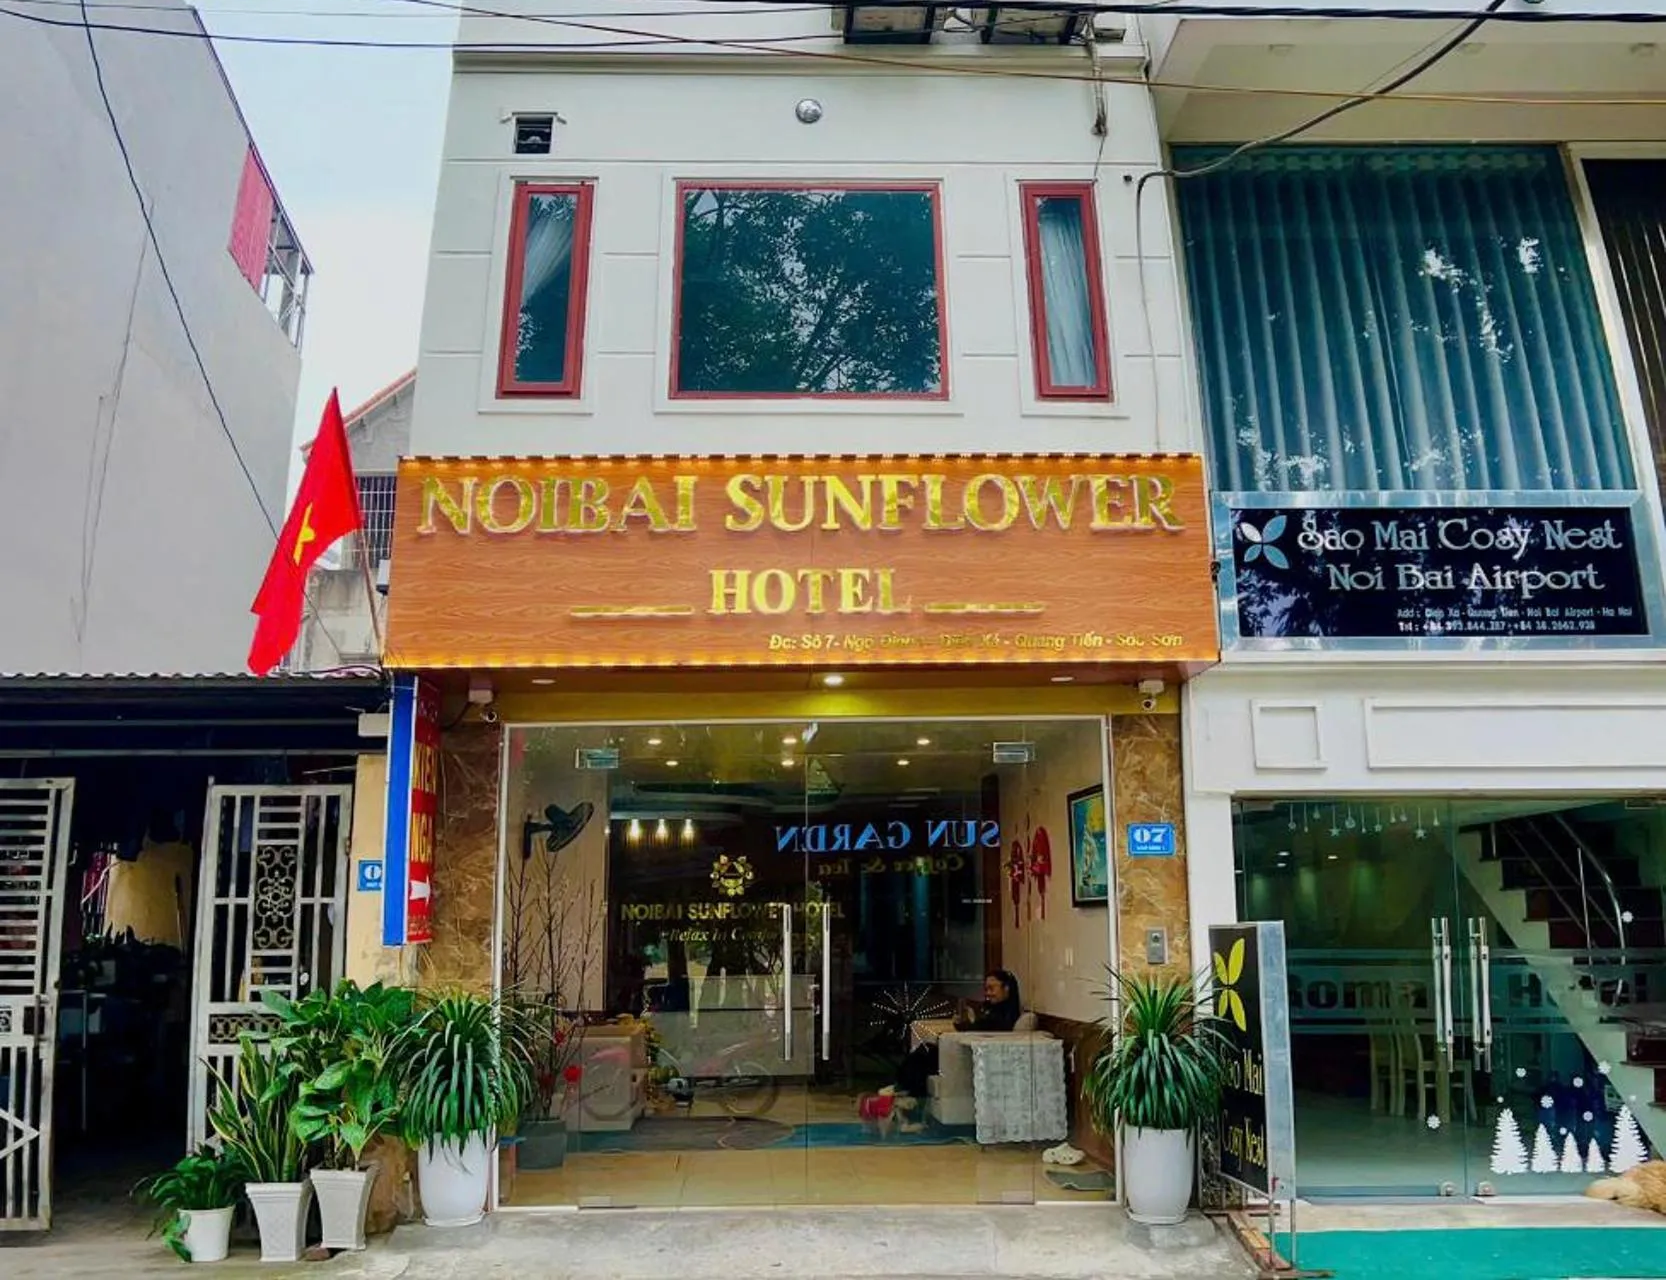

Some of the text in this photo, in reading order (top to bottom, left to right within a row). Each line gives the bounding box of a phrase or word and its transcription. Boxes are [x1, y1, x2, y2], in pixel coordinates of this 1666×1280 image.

[416, 473, 1186, 535] NOIBAI SUNFLOWER
[1298, 519, 1623, 559] Sao Mai Cosy Nest
[707, 568, 912, 615] HOTEL
[1327, 562, 1606, 599] Noi Bai Airport
[1133, 827, 1167, 843] 07
